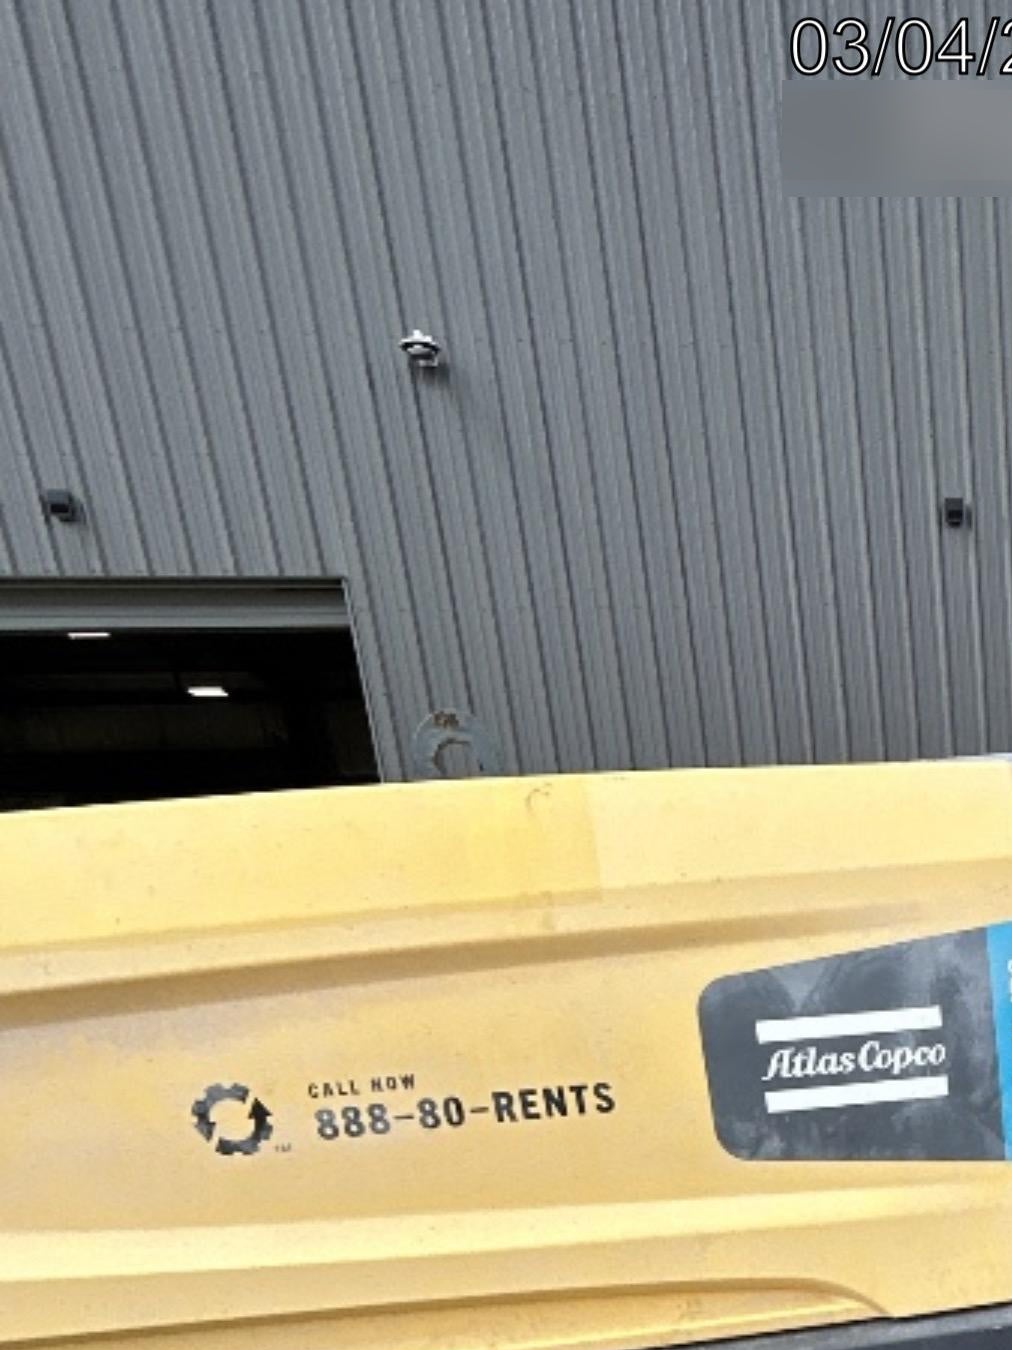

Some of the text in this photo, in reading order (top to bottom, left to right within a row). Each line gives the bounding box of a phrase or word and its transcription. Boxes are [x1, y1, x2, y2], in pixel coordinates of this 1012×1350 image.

[761, 1040, 946, 1081] Atlas Copco
[308, 1073, 415, 1098] CALL NOW
[315, 1082, 617, 1140] 888-80-RENTS
